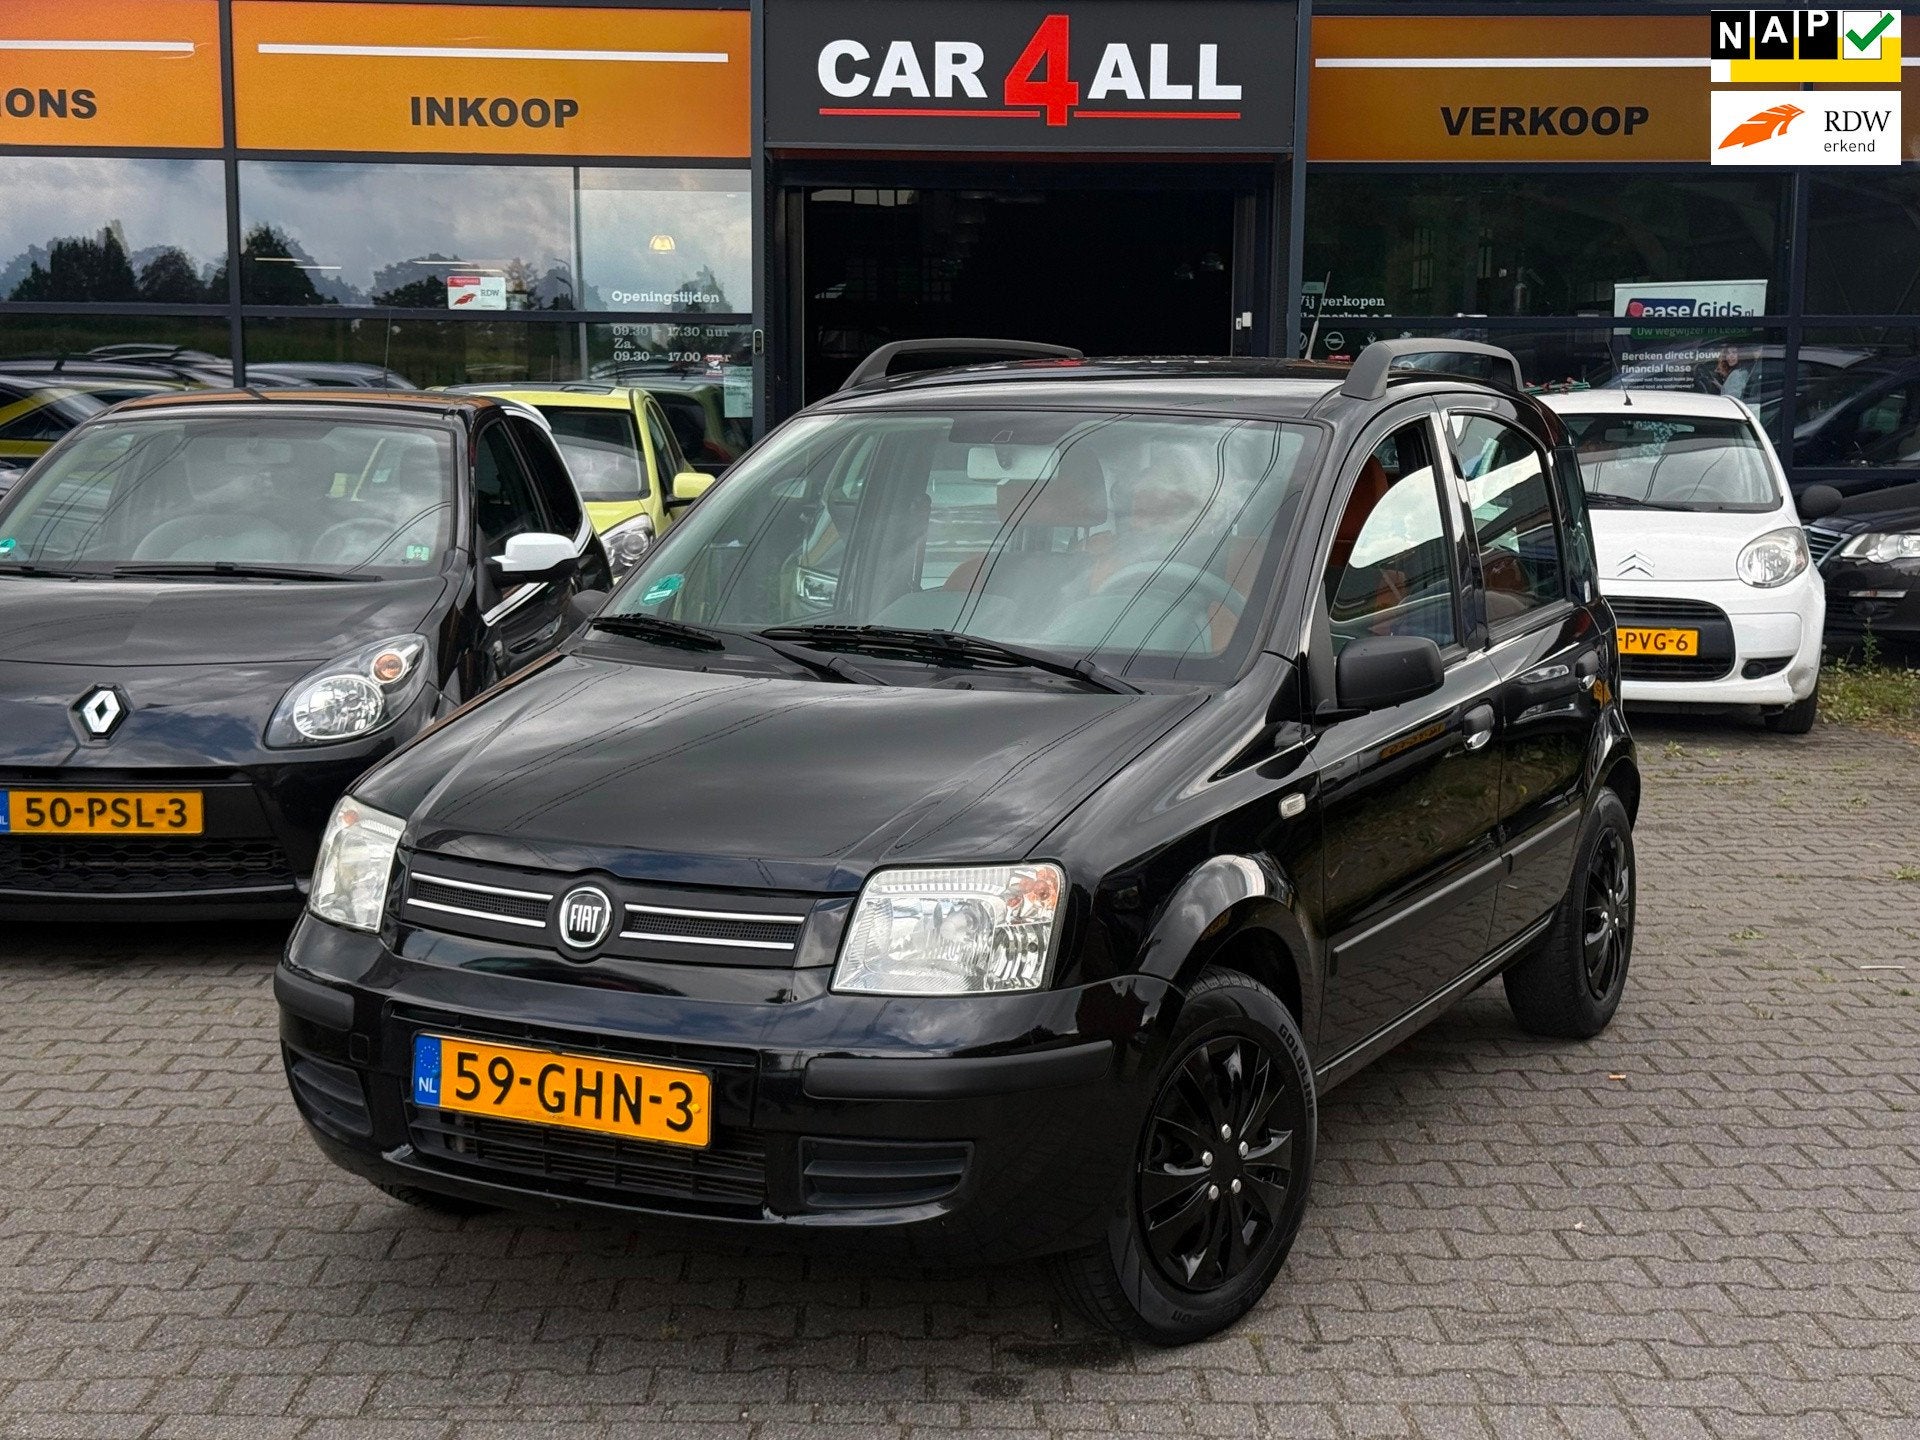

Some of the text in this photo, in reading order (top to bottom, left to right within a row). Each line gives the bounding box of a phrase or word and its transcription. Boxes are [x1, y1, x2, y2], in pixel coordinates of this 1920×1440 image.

[817, 14, 1242, 126] CAR 4 ALL
[0, 87, 97, 119] ONS
[411, 96, 578, 128] INKOOP
[1441, 106, 1649, 136] VERKOOP
[611, 290, 720, 305] Openingstijden
[1321, 295, 1385, 309] verkopen
[613, 325, 649, 336] 09.30
[667, 326, 700, 337] 17.30
[614, 337, 635, 349] Za.
[613, 351, 650, 361] 09.30
[668, 352, 701, 362] 17.00
[1621, 349, 1720, 361] Bereken direct jouw
[1621, 364, 1692, 374] financial lease
[25, 797, 188, 828] 50-PSL-3
[569, 904, 602, 934] FIAT
[418, 1051, 695, 1132] NL 59-GHN-3
